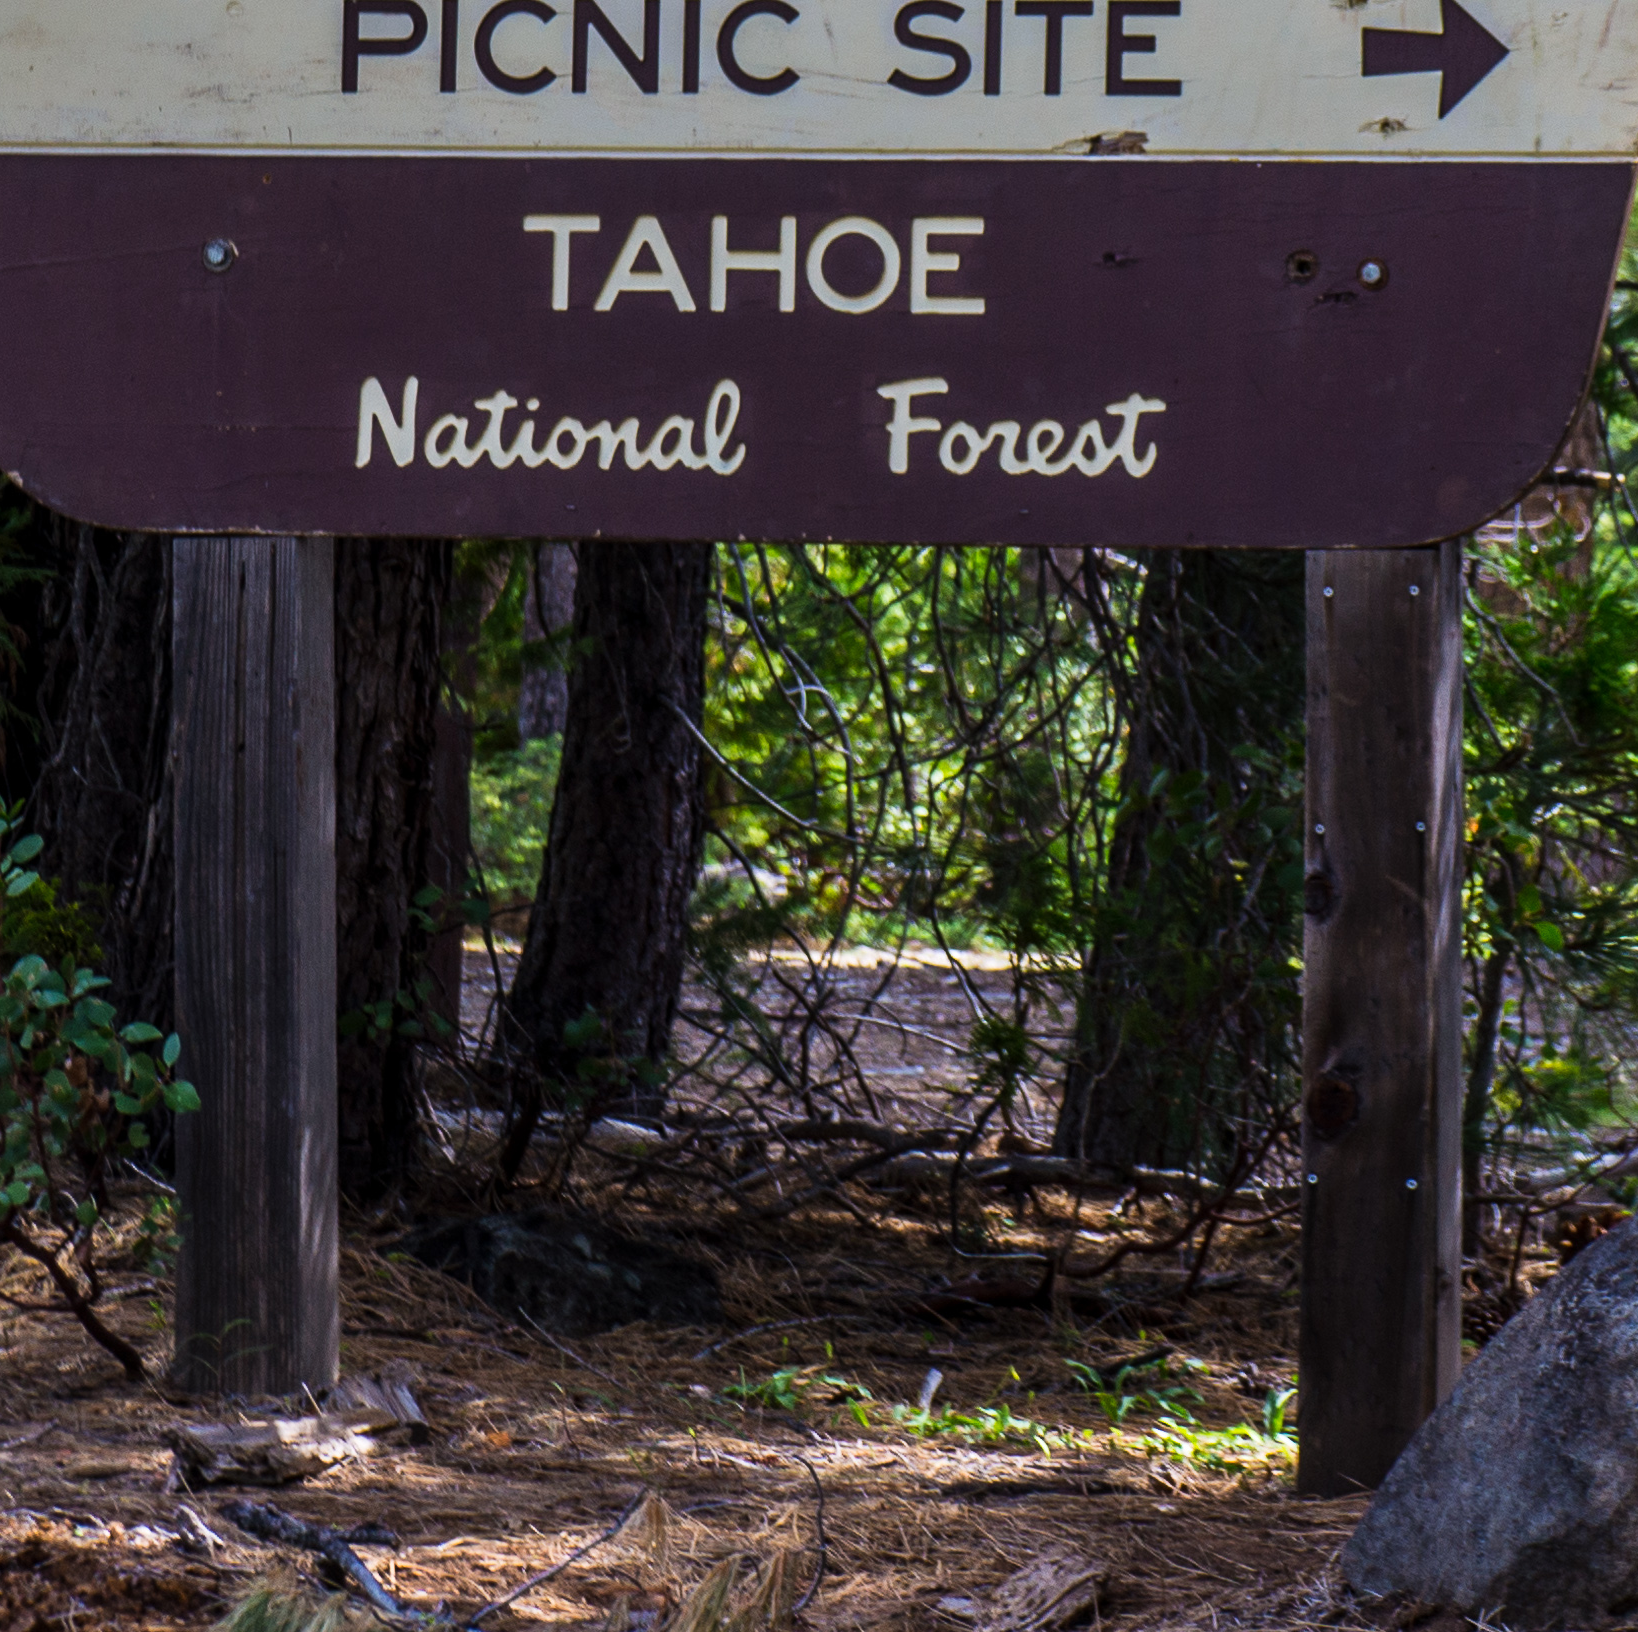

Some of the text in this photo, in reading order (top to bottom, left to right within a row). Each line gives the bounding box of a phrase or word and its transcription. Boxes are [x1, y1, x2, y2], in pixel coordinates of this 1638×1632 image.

[887, 0, 1182, 96] SITE
[524, 216, 985, 314] TAHOE
[356, 377, 1165, 476] National Forest
